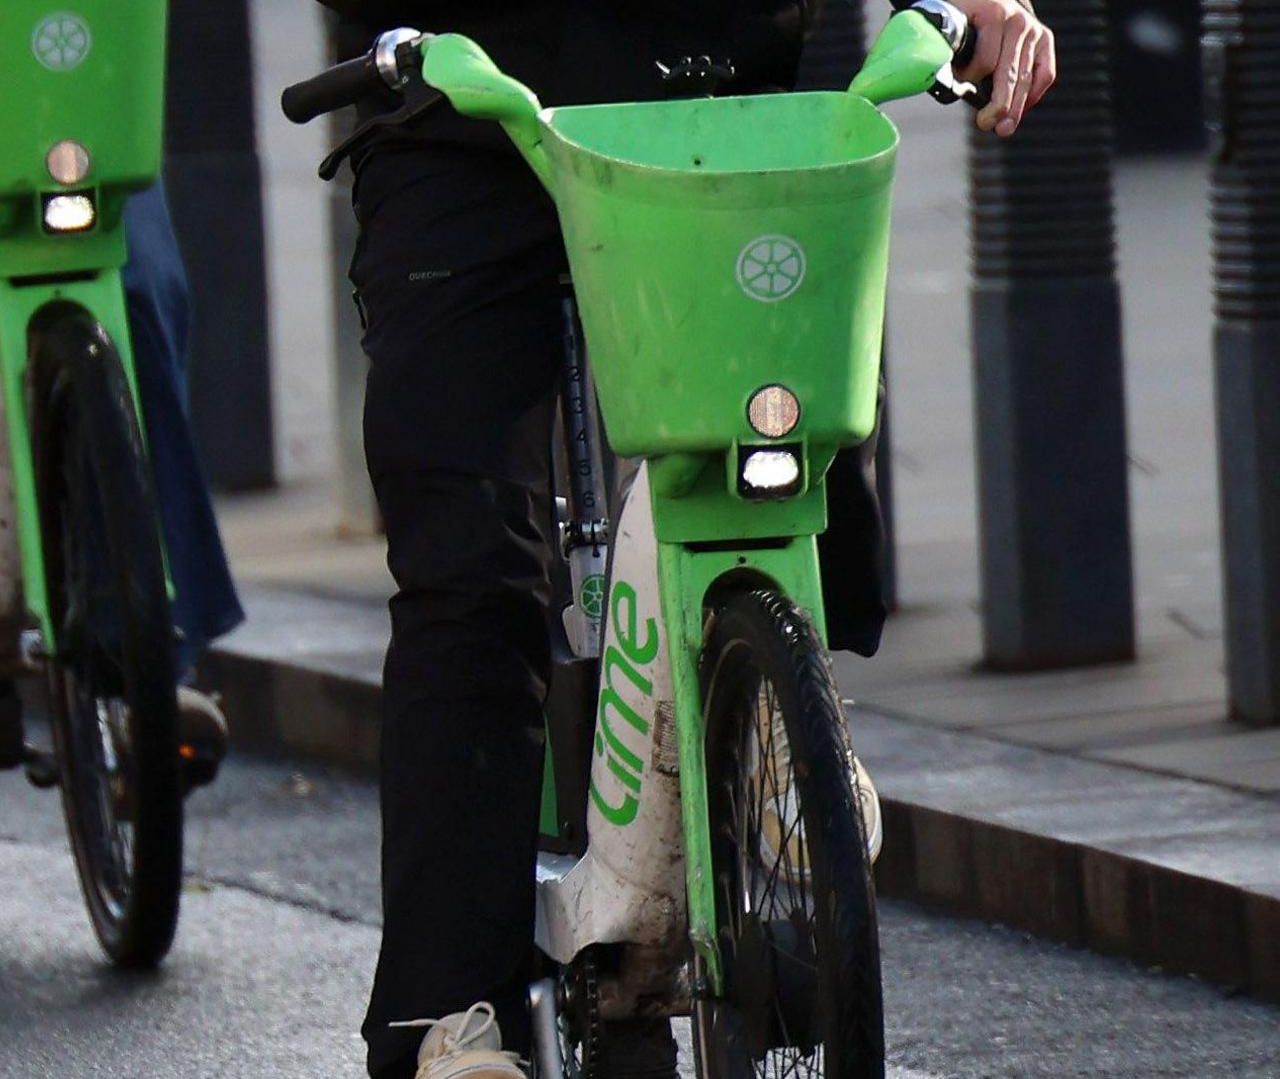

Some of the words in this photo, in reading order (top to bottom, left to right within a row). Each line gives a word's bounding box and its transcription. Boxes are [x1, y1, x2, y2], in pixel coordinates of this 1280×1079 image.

[568, 366, 581, 381] 2
[572, 397, 584, 413] 3
[576, 428, 587, 443] 4
[580, 459, 591, 476] 5
[584, 490, 595, 507] 6
[588, 580, 659, 826] Lime
